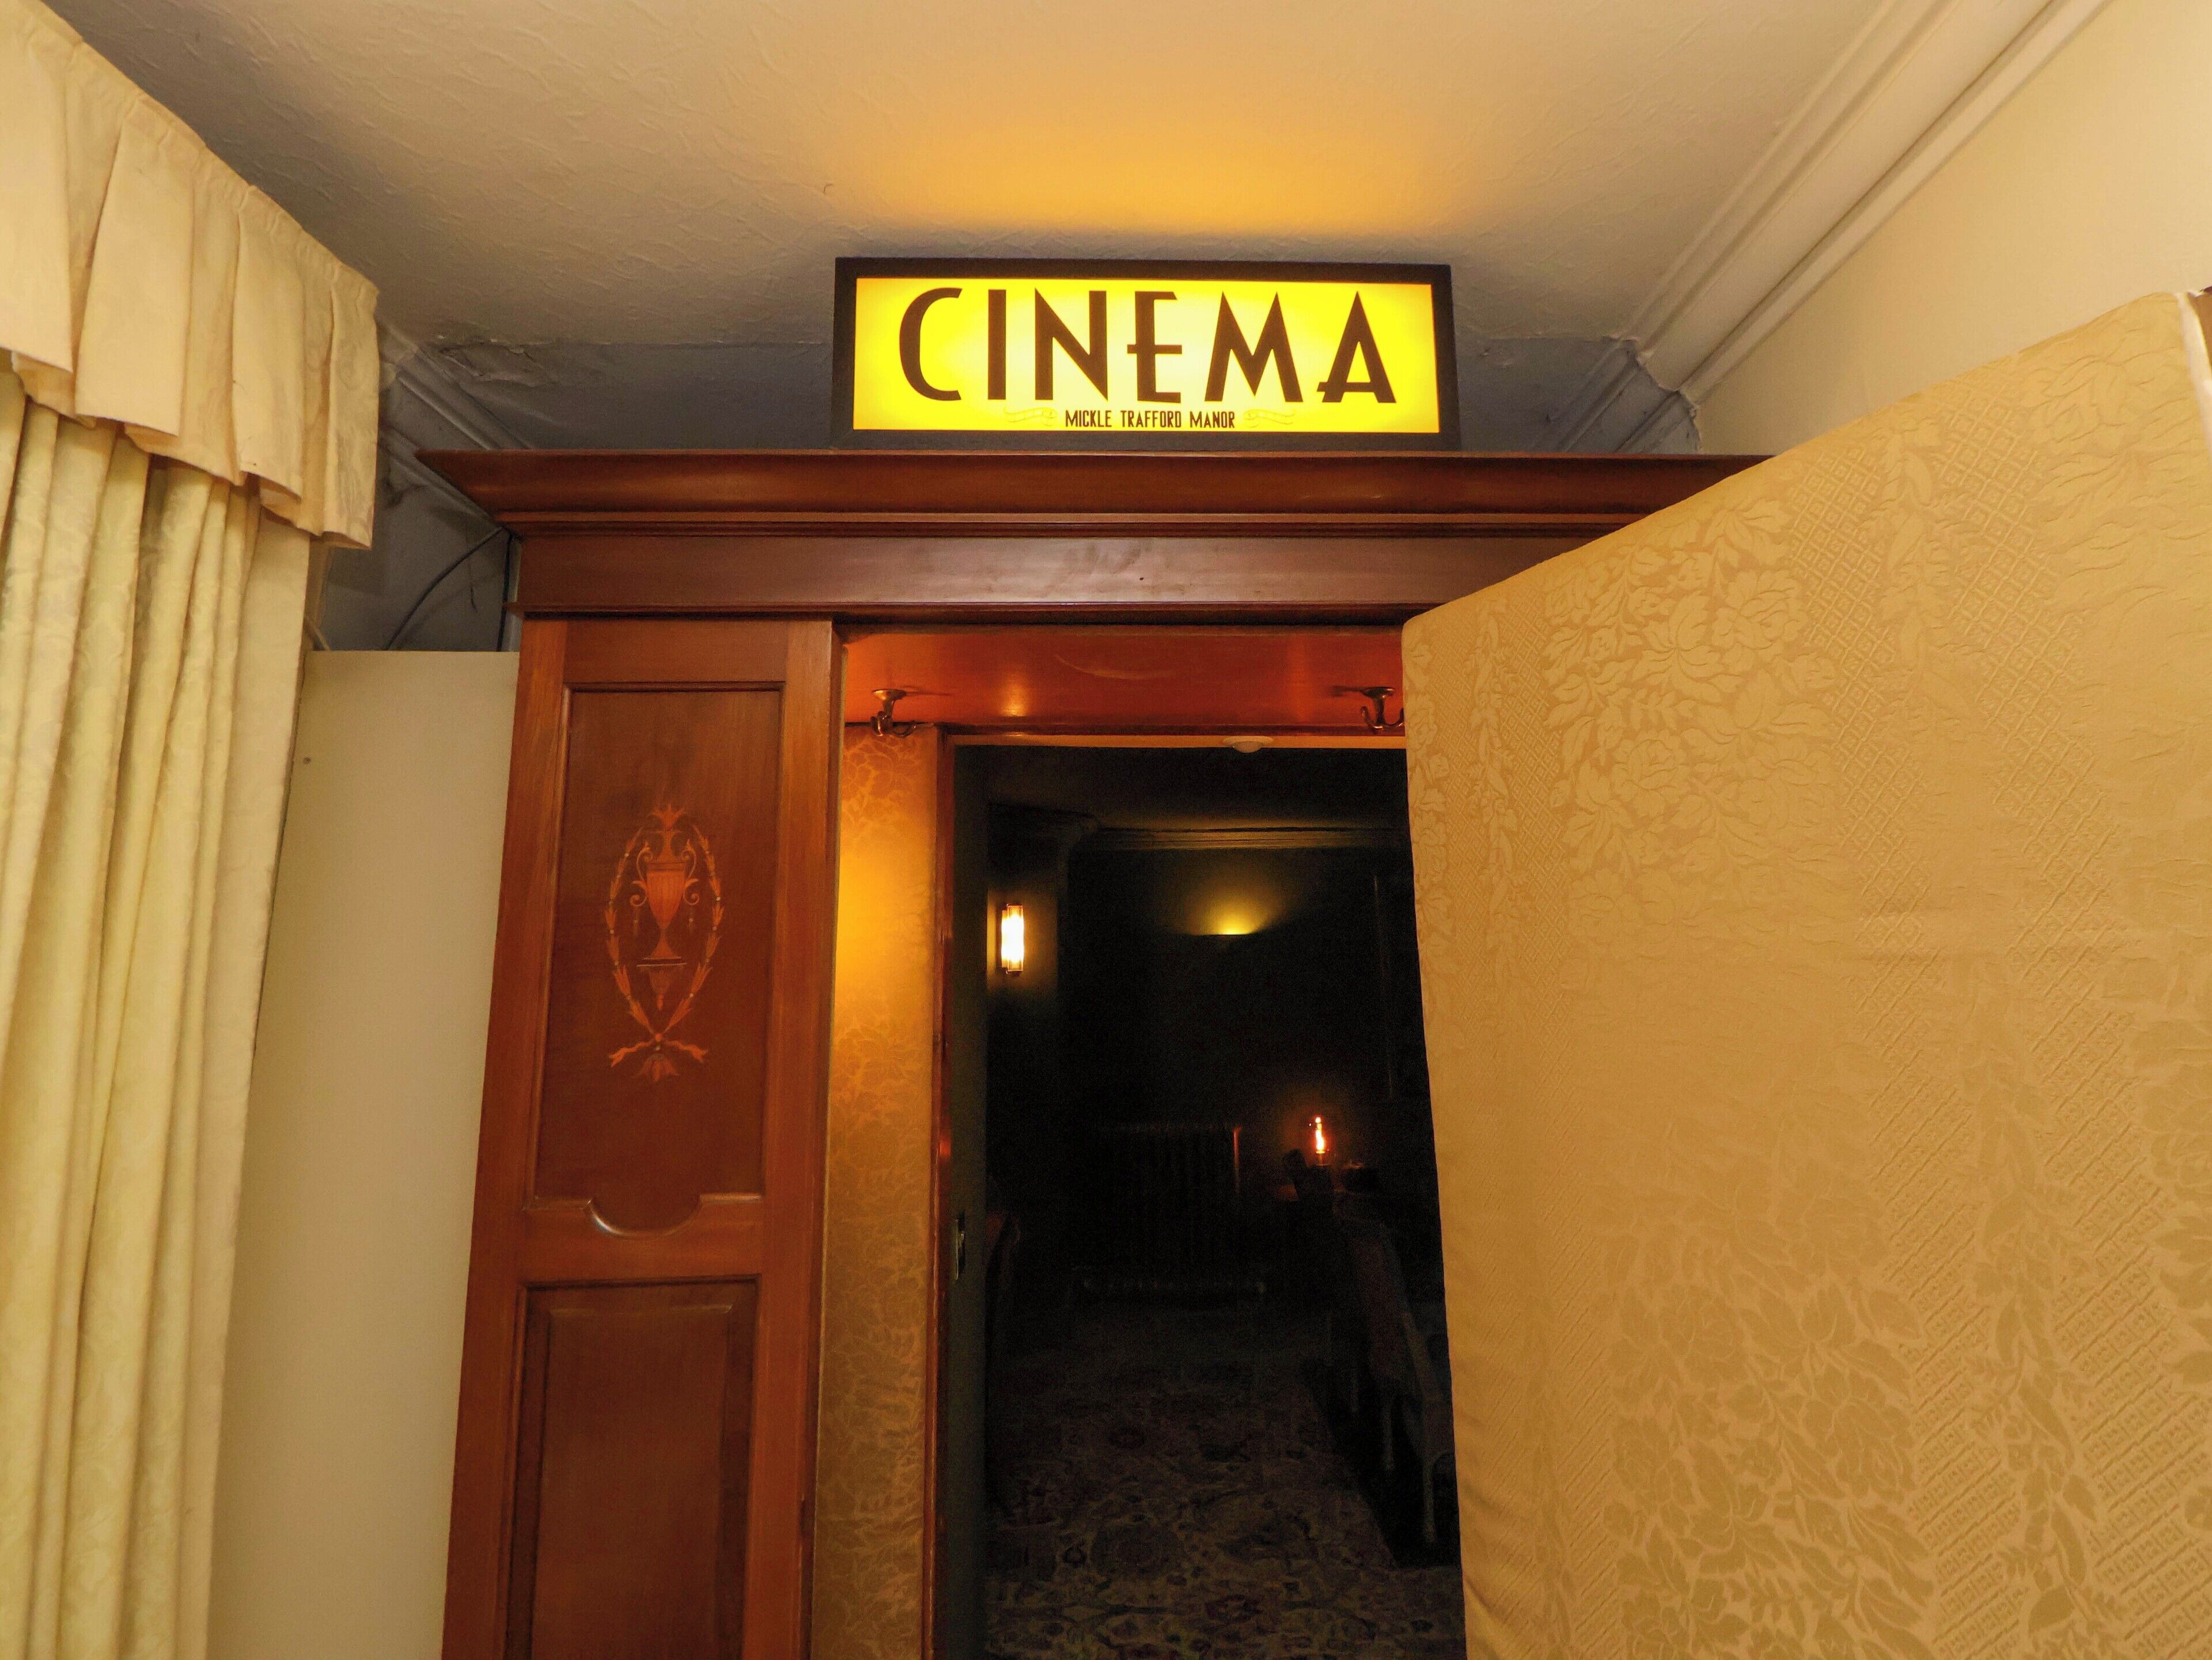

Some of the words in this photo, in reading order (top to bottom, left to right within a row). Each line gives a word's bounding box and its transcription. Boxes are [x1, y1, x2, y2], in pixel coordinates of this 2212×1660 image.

[899, 287, 1396, 404] CINEMA
[1065, 410, 1112, 427] MICKLE
[1120, 410, 1181, 428] TRAFFORD
[1190, 411, 1235, 429] MANOR
